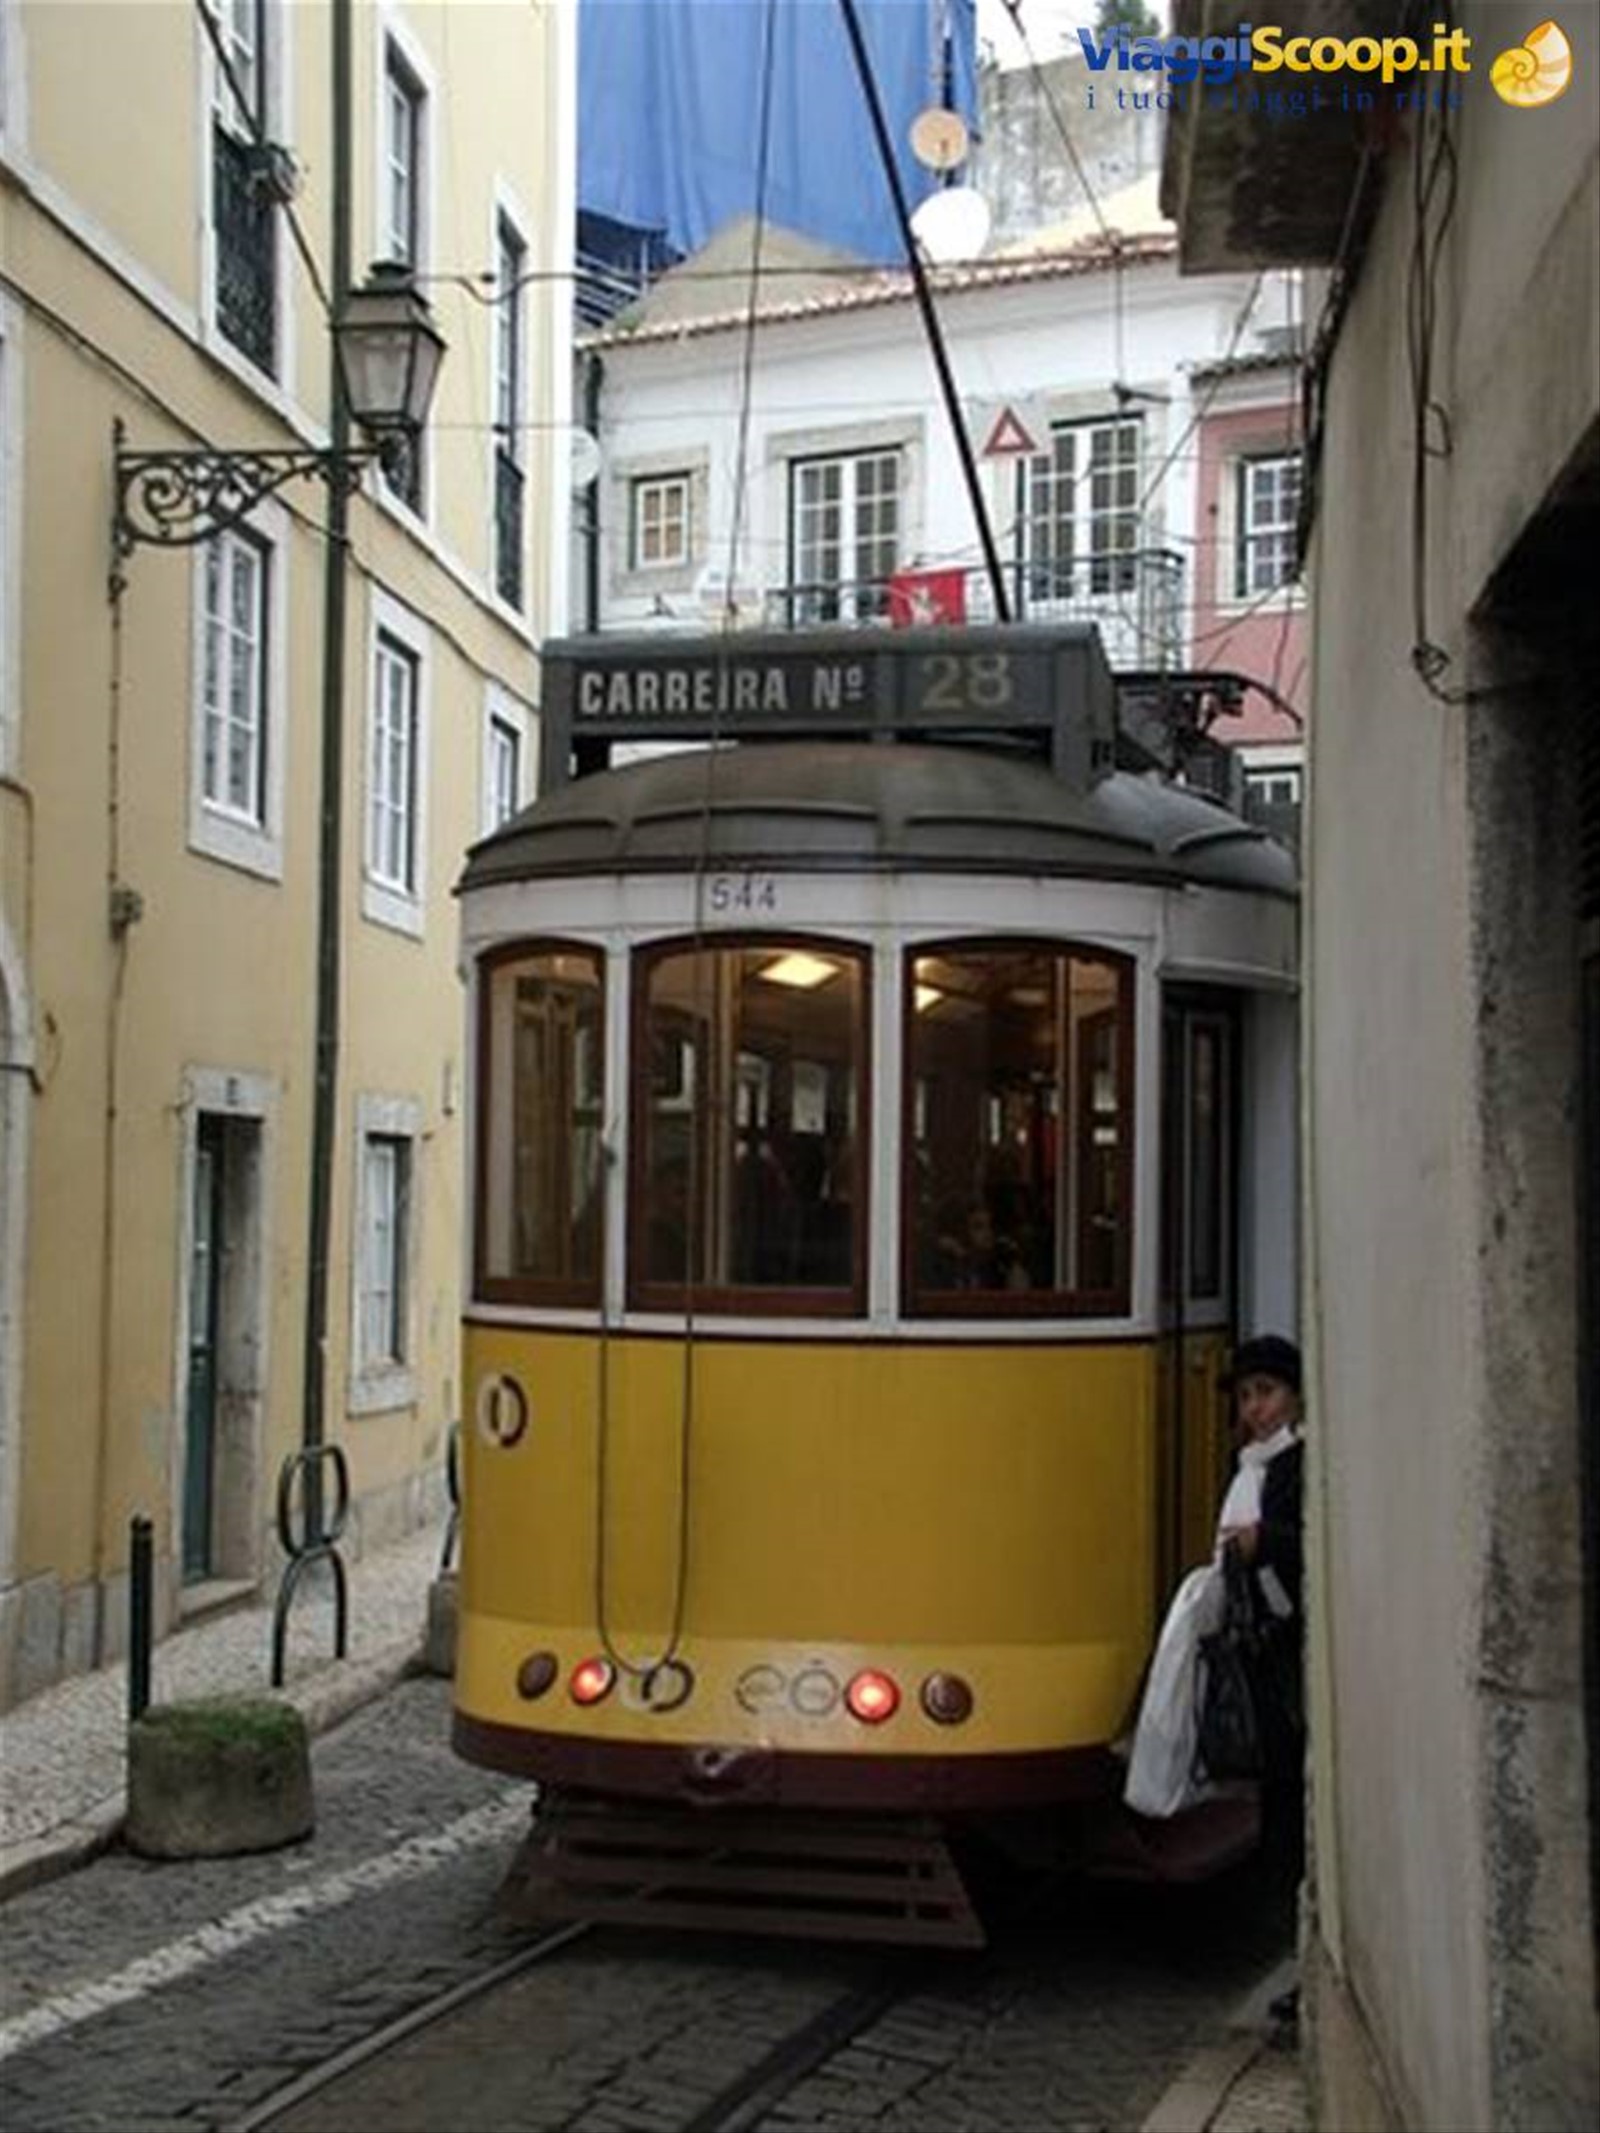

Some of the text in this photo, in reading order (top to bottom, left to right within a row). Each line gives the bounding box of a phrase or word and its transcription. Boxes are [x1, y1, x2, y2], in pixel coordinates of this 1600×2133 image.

[580, 669, 788, 714] CARREIRA
[920, 652, 1012, 710] 28
[711, 876, 775, 911] 544
